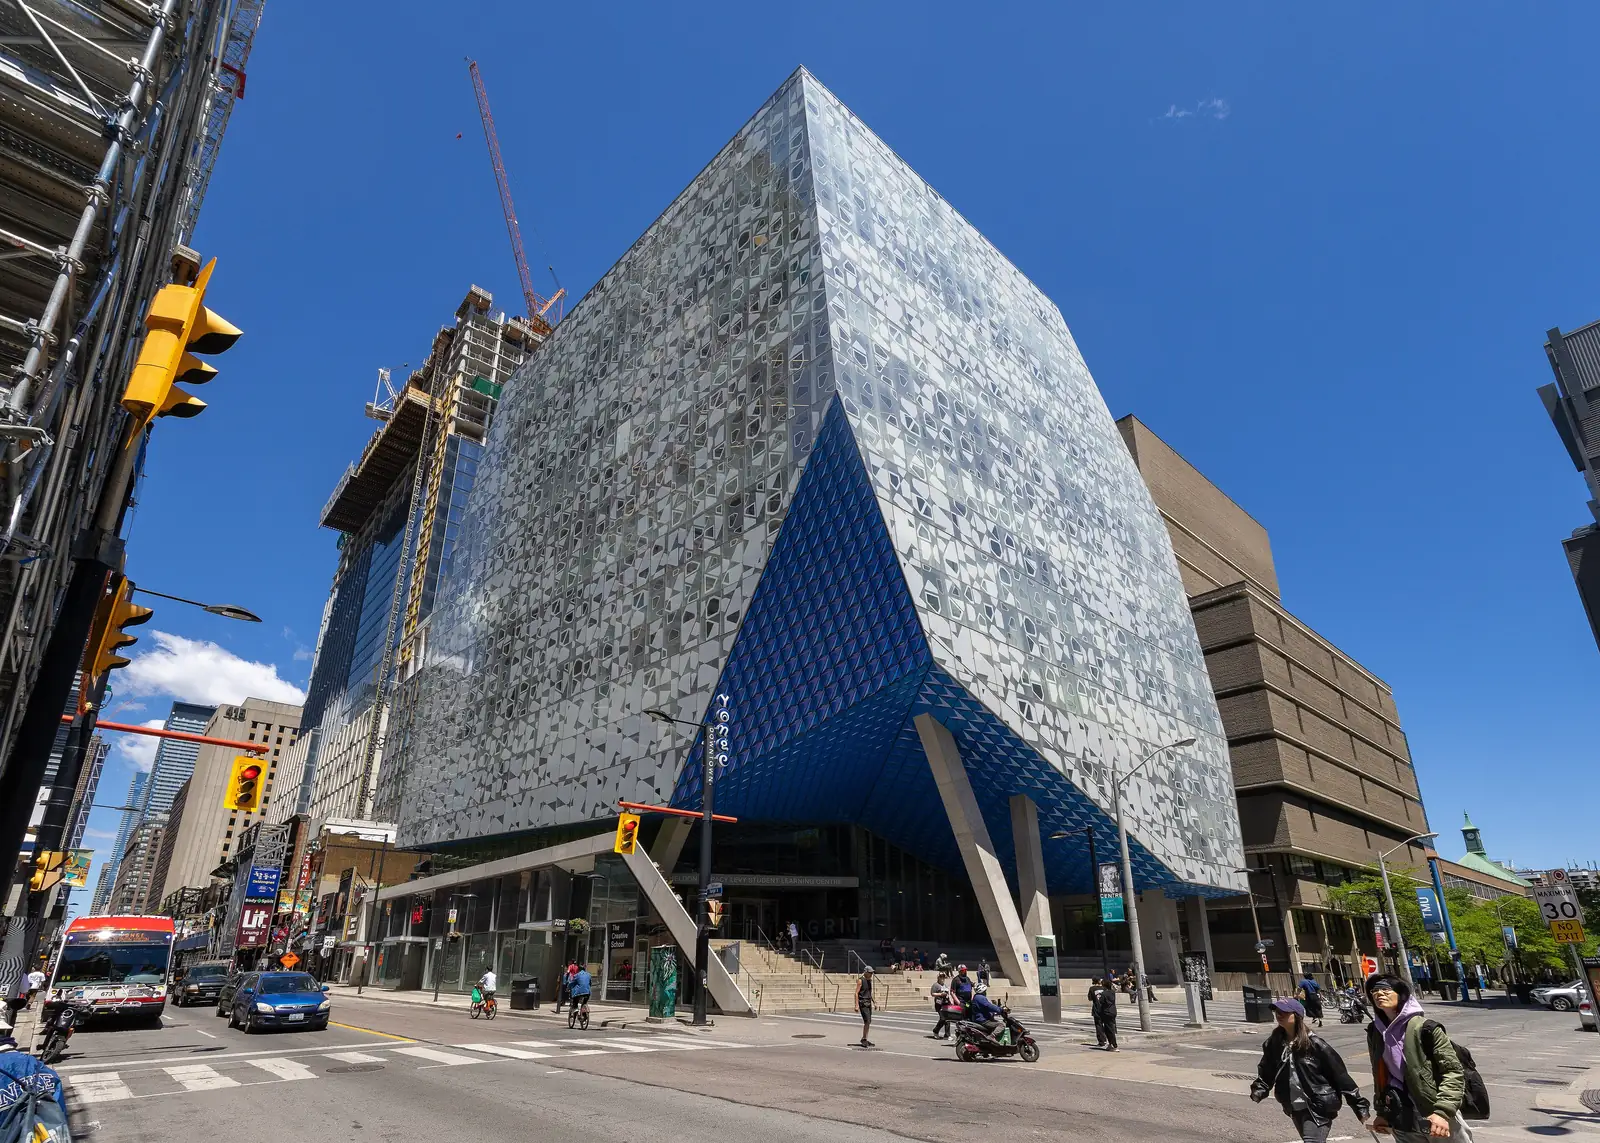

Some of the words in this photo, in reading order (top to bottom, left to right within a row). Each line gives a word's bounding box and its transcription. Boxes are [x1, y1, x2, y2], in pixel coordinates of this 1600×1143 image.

[748, 876, 780, 884] STUDENT
[781, 877, 815, 885] LEARNING
[1537, 889, 1573, 898] MAXIMUM
[1419, 896, 1433, 918] TMU
[1543, 901, 1577, 920] 30
[242, 908, 269, 929] Lit
[808, 917, 859, 936] GRIT
[1557, 922, 1573, 931] NO
[612, 931, 629, 940] Creative
[1557, 932, 1580, 941] EXIT
[610, 940, 625, 949] School
